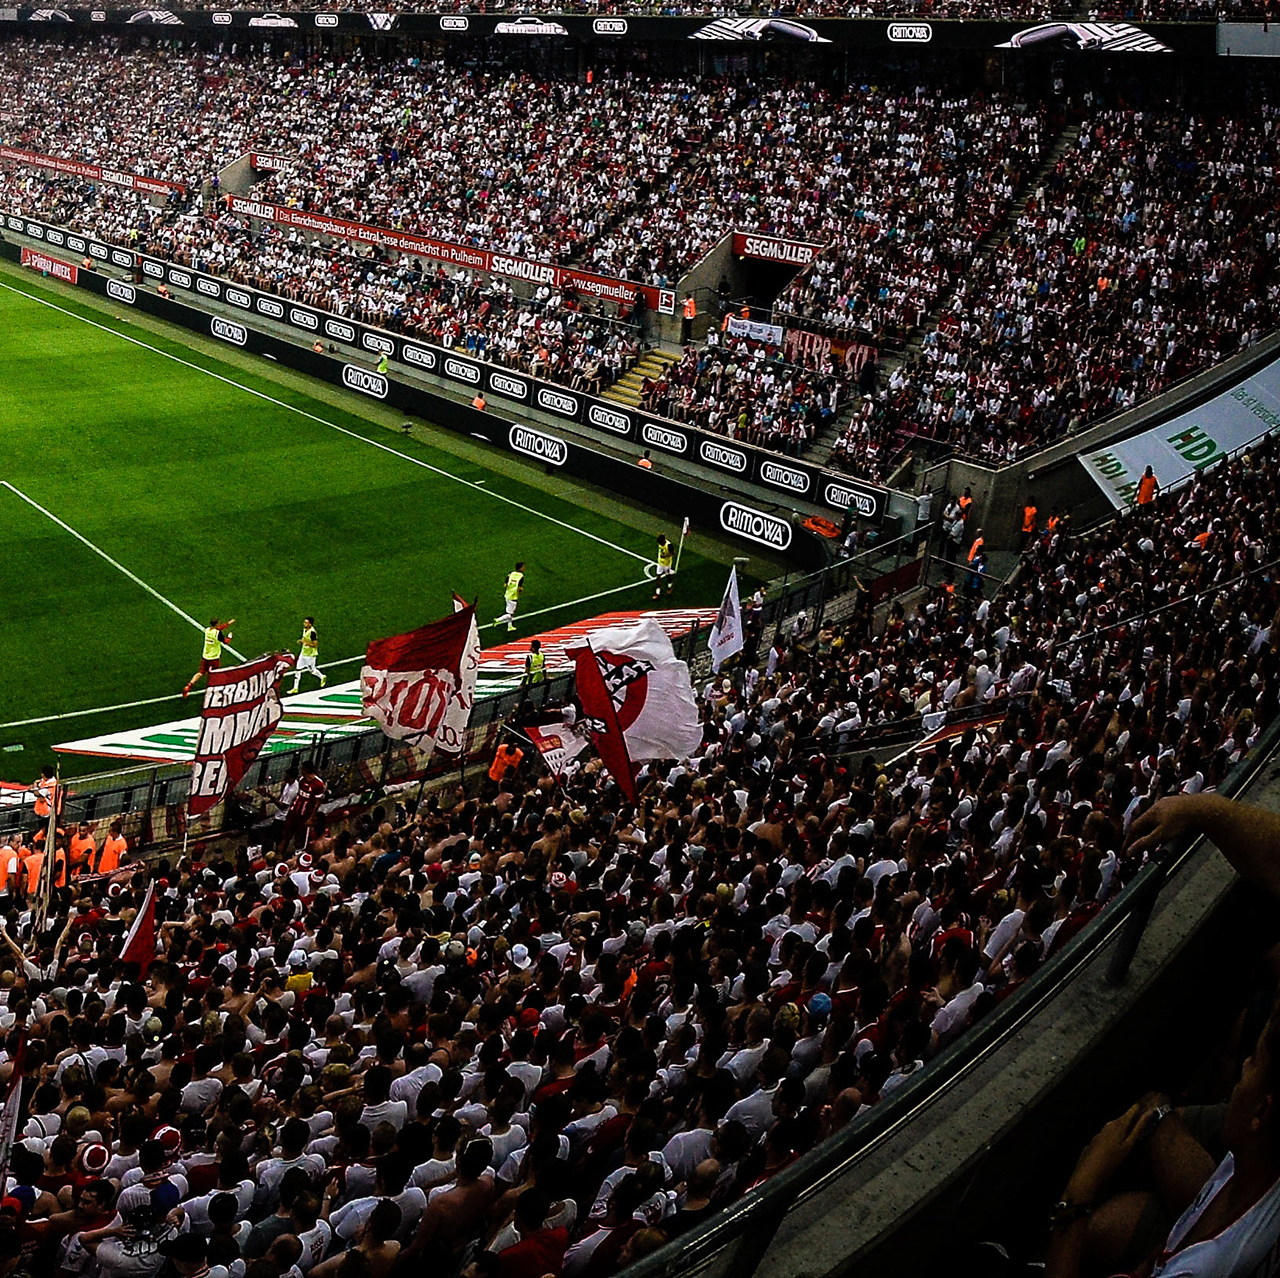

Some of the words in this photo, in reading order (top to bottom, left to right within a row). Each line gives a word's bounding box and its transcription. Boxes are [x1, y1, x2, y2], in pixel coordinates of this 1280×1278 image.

[892, 26, 927, 38] RIMOWA
[232, 199, 274, 220] SEGMÜLLER
[291, 212, 346, 235] Einrichtungshaus
[399, 238, 439, 257] demnächst
[441, 246, 449, 258] in
[451, 248, 483, 267] Pulheim
[491, 255, 555, 285] SEGMÜLLER
[744, 238, 813, 264] SEGMÜLLER
[216, 319, 244, 342] RIMOWA
[348, 368, 383, 395] RIMOWA
[449, 362, 477, 381] RIMOWA
[494, 376, 523, 396] RIMOWA
[542, 391, 574, 412] RIMOWA
[593, 410, 626, 431] RIMOWA
[516, 431, 561, 460] RIMOWA
[648, 428, 682, 450] RIMOWA
[1167, 425, 1227, 470] HDI
[706, 446, 742, 468] RIMOWA
[1091, 452, 1128, 480] HDI
[766, 466, 804, 489] RIMOWA
[728, 506, 784, 546] RIMOWA
